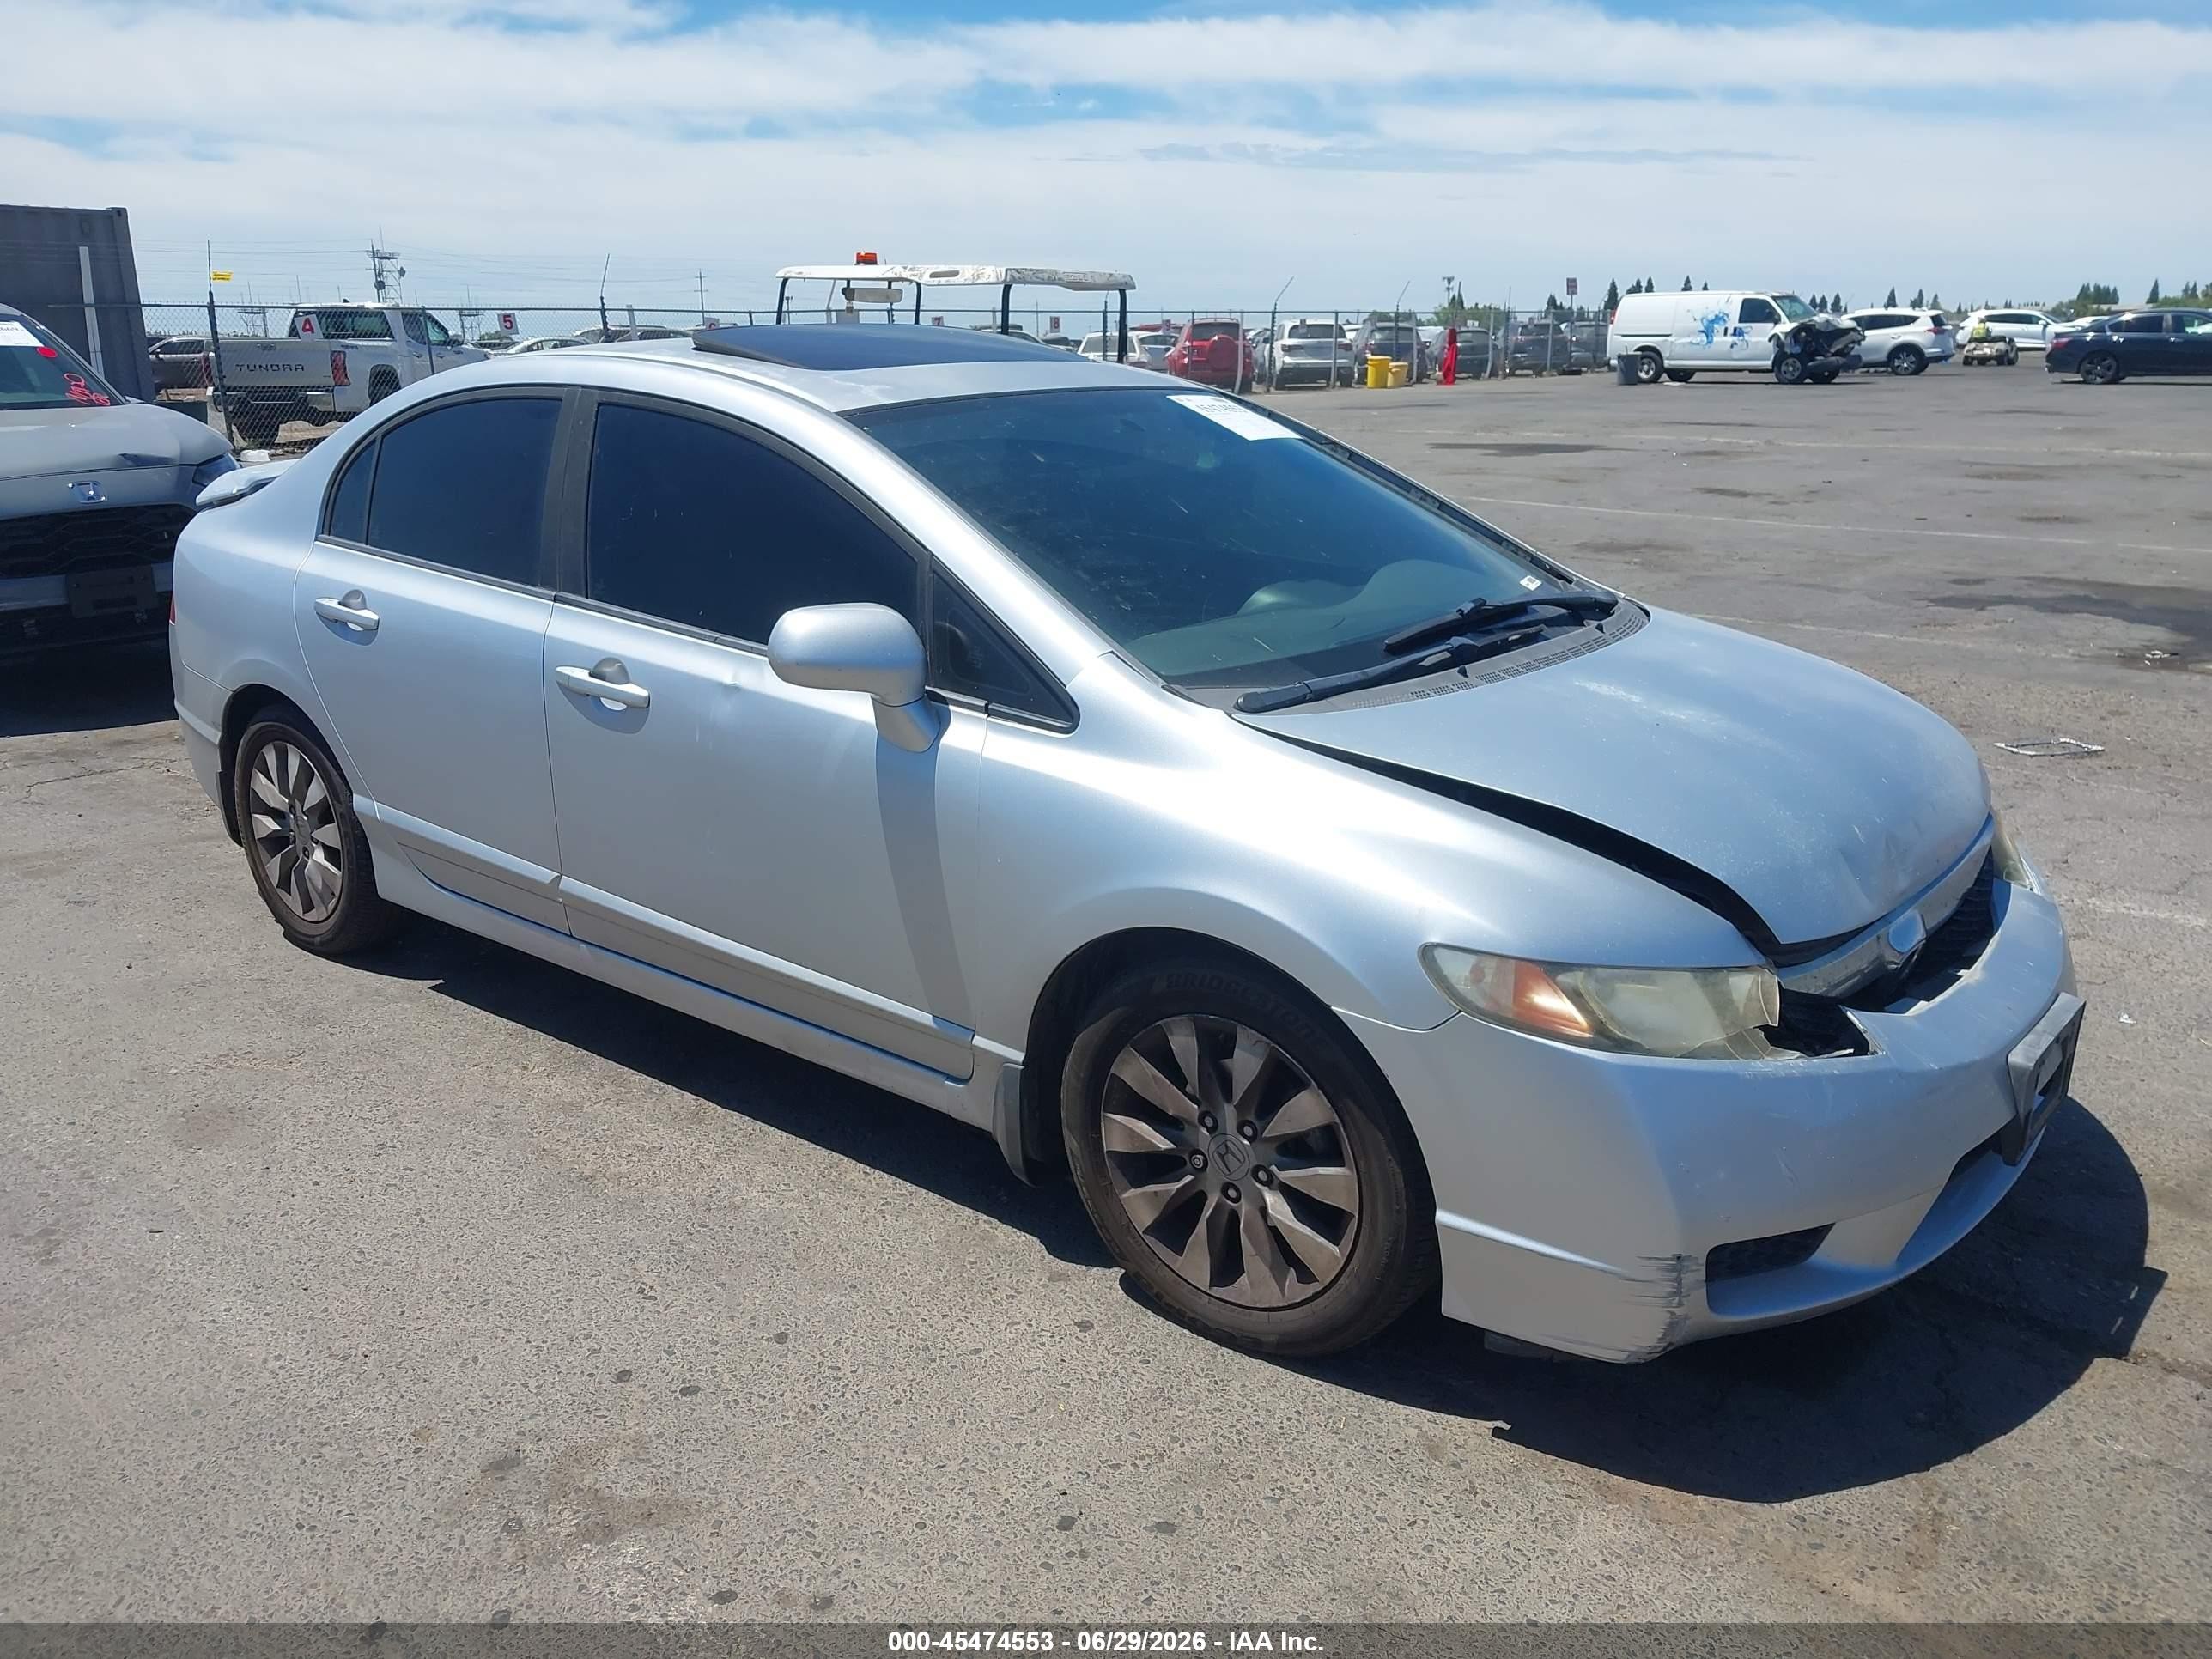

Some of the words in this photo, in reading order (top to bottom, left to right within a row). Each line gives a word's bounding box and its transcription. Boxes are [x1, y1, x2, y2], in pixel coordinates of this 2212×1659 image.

[502, 314, 514, 330] 5
[234, 363, 305, 372] TUNDRA
[1166, 972, 1327, 1048] BRIDGESTON
